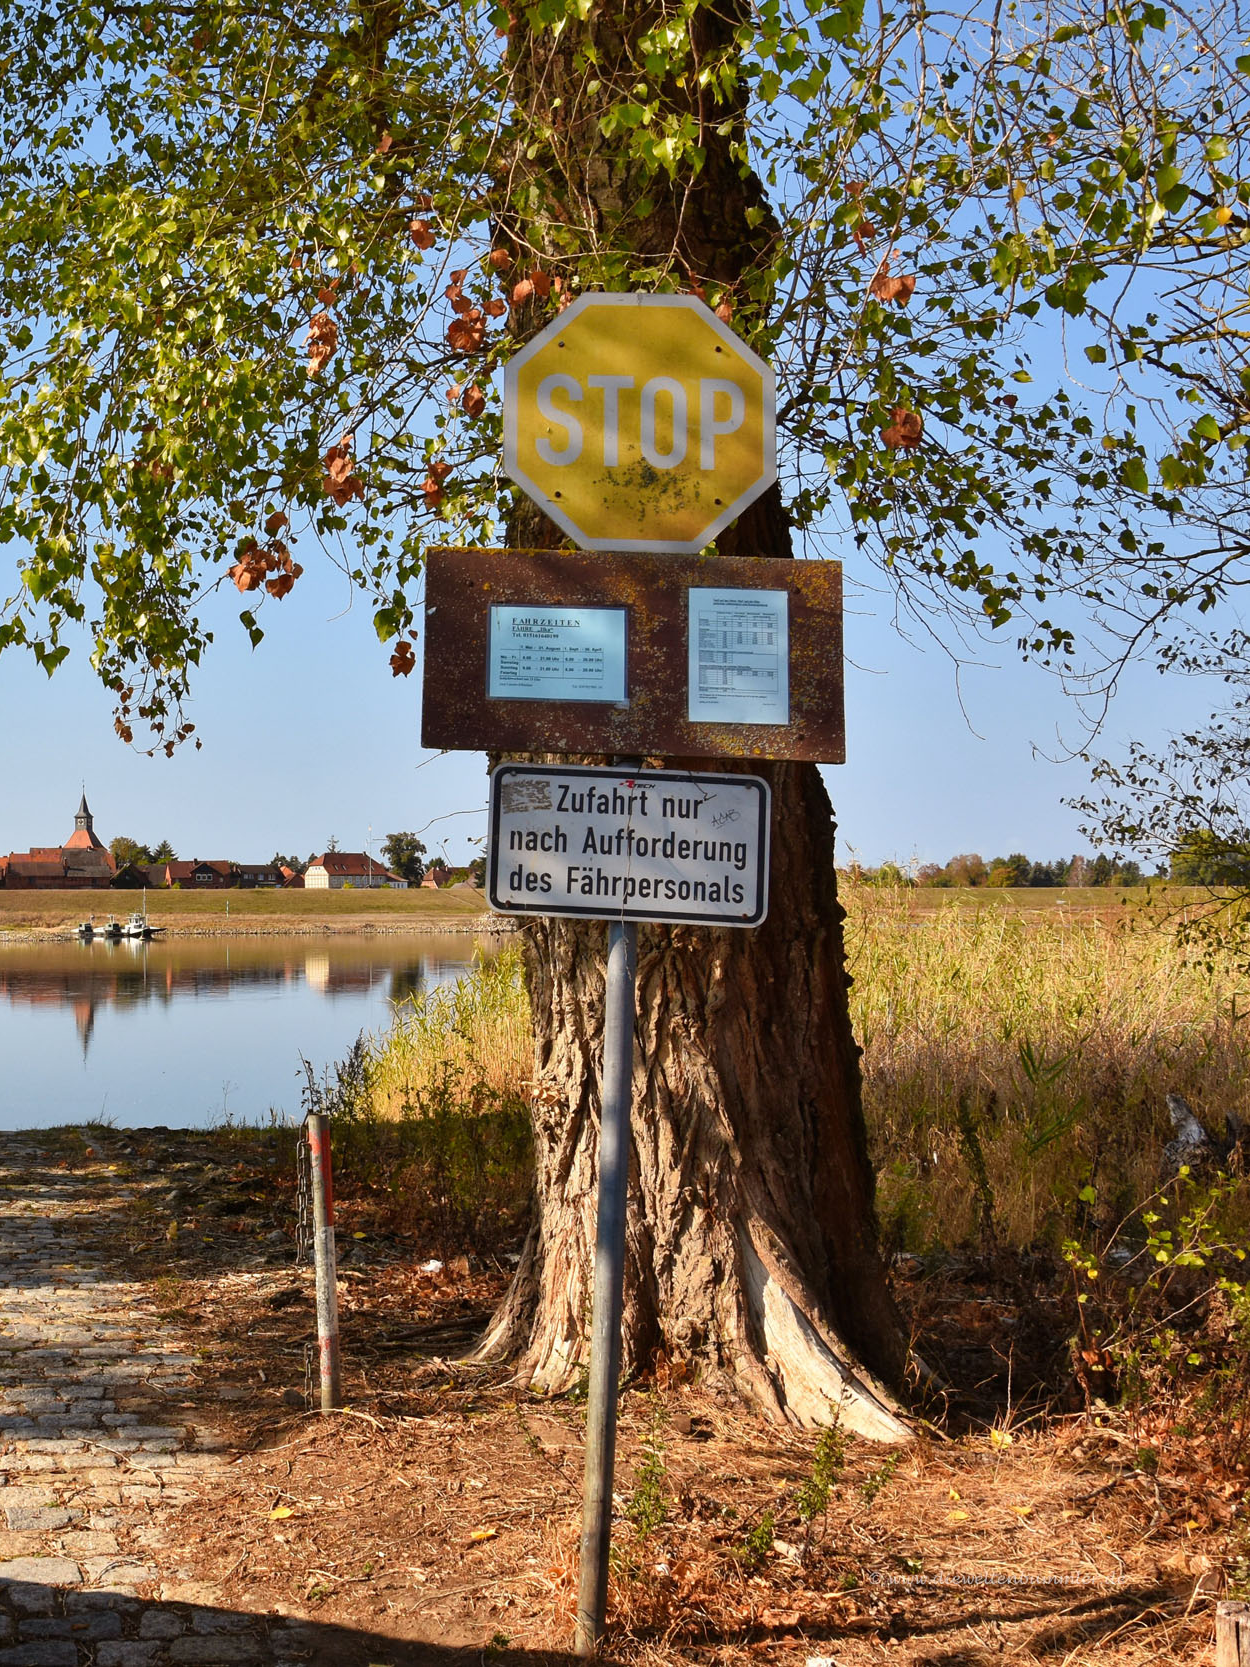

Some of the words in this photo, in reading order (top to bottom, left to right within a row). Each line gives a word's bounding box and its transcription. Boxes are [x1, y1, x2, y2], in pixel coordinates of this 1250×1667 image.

[535, 373, 745, 471] STOP
[557, 785, 648, 816] Zufahrt
[662, 796, 704, 819] nur
[509, 825, 568, 853] nach
[582, 826, 747, 871] Aufforderung
[509, 864, 552, 893] des
[566, 866, 745, 905] Fährpersonals
